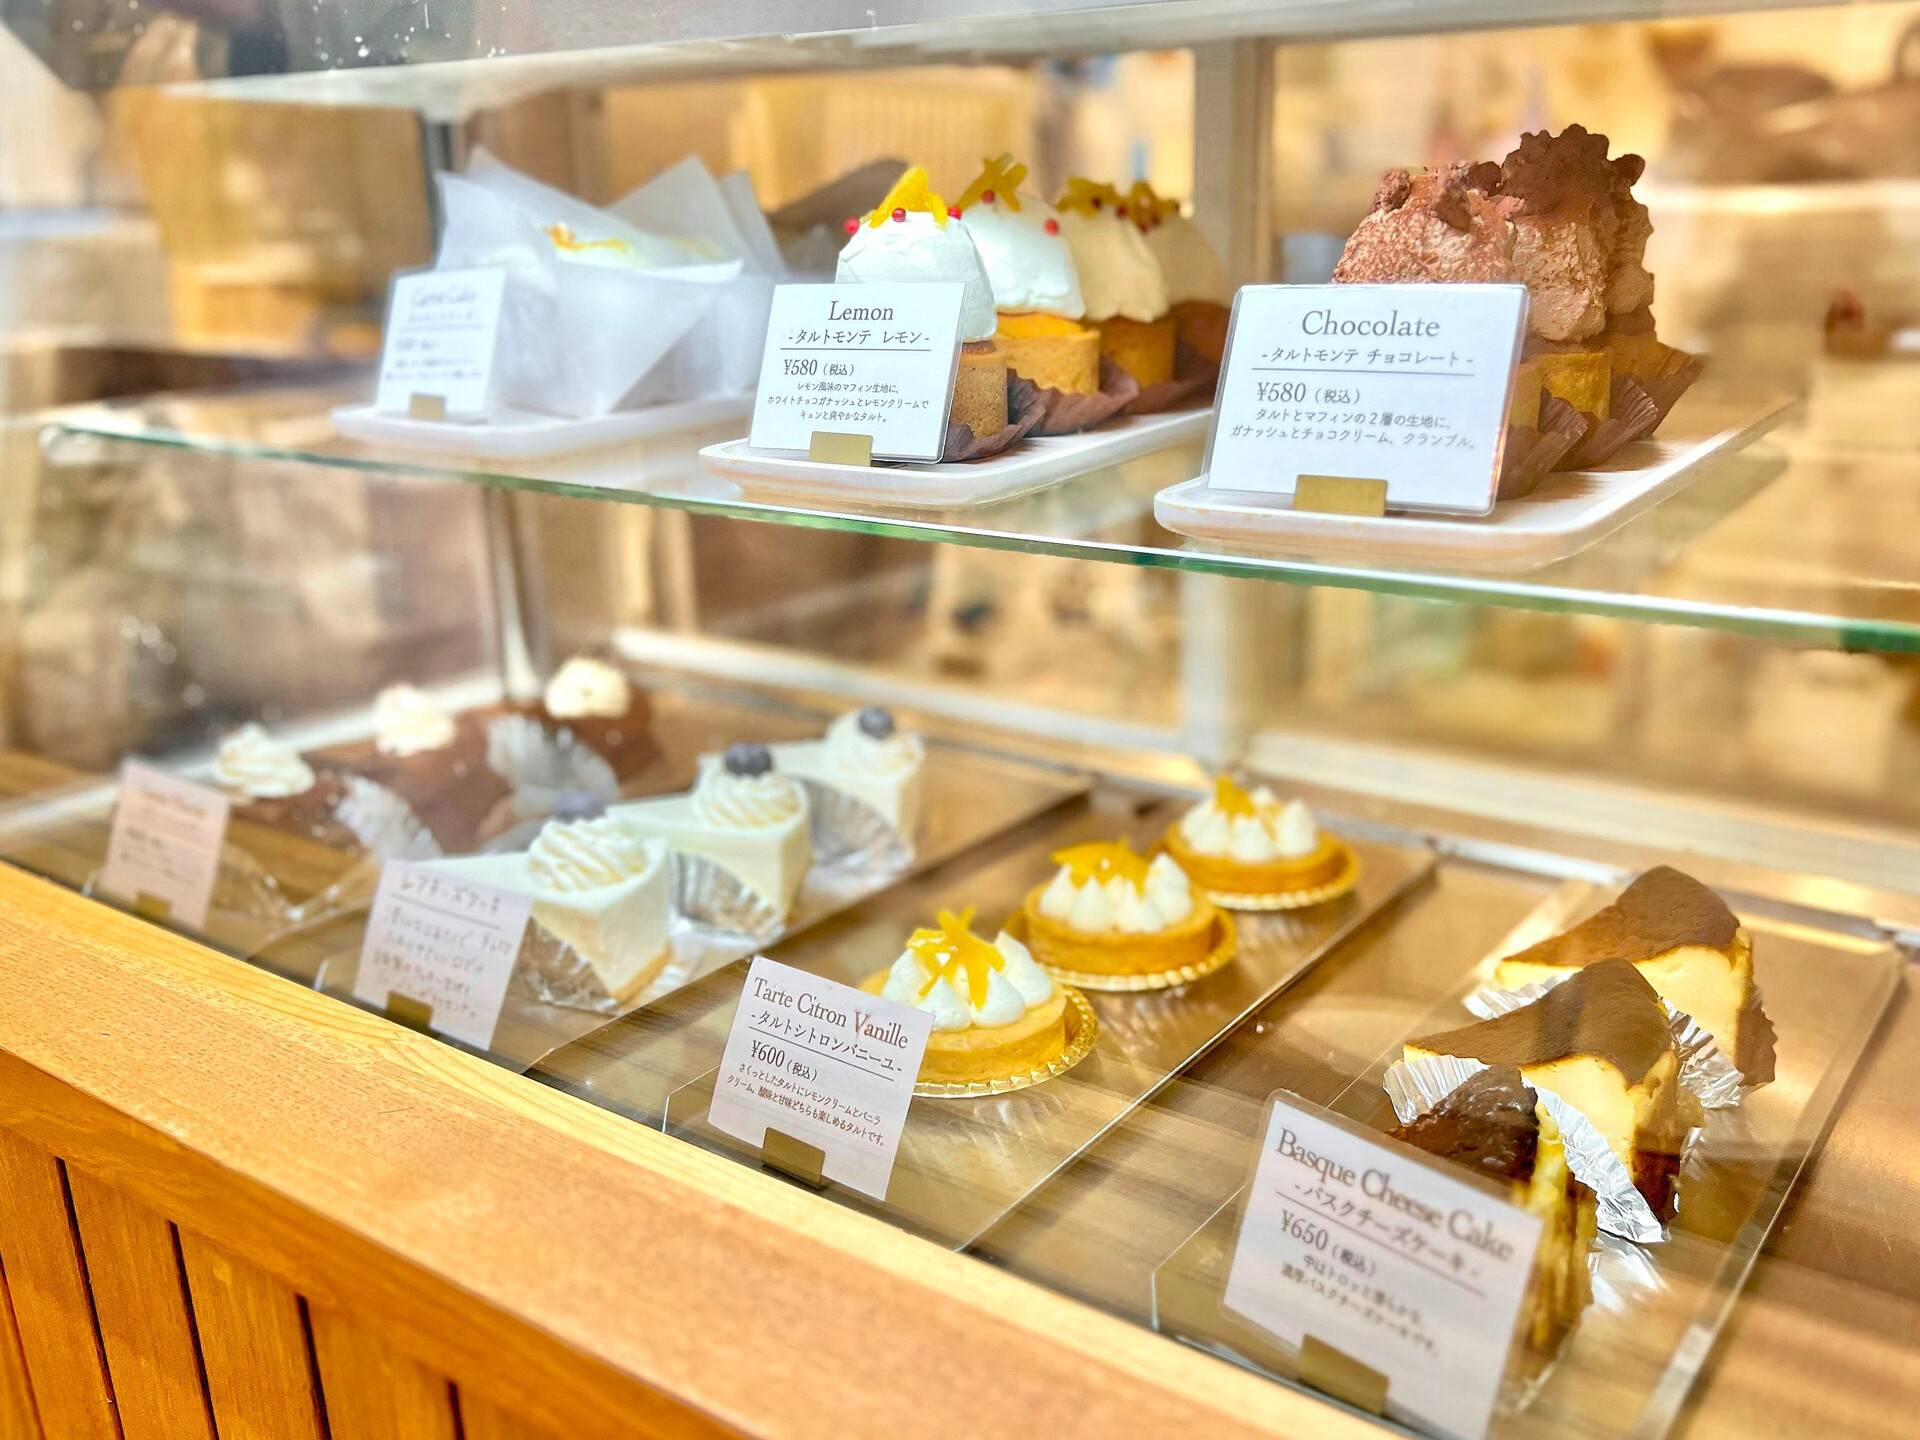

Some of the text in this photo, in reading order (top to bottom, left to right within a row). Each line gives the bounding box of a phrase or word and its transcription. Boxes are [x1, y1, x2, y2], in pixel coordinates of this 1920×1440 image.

[827, 300, 894, 321] Lemon
[1301, 309, 1440, 337] Chocolate
[797, 381, 899, 394] レモン風味のマフィン生地に、
[767, 395, 930, 409] ホワイトチョコガナッシュとレモンクリームで
[800, 410, 887, 423] キュンと爽やかなタルト。
[753, 977, 909, 1050] Tarte Citron Vanille
[738, 1062, 881, 1126] さくっとしたタルトにレモンクリームとバニラ
[1276, 1127, 1516, 1263] Basque Cheese Cake
